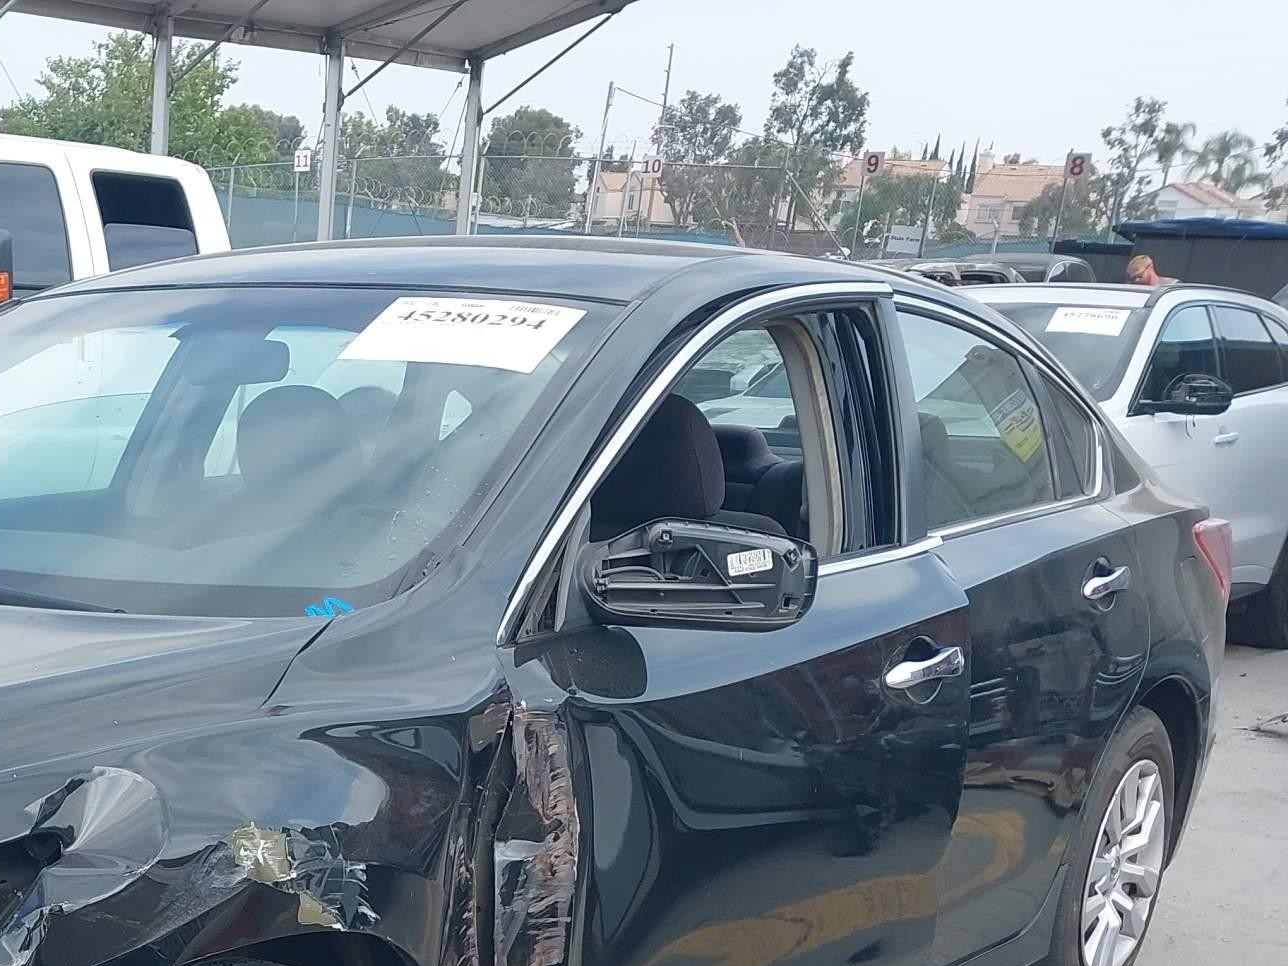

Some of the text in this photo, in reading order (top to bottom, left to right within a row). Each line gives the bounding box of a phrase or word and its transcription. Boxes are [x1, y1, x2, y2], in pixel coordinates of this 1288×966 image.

[295, 155, 309, 168] 11
[641, 159, 662, 174] 10
[867, 155, 880, 174] 9
[1070, 155, 1085, 176] 8
[397, 309, 547, 331] 45280294
